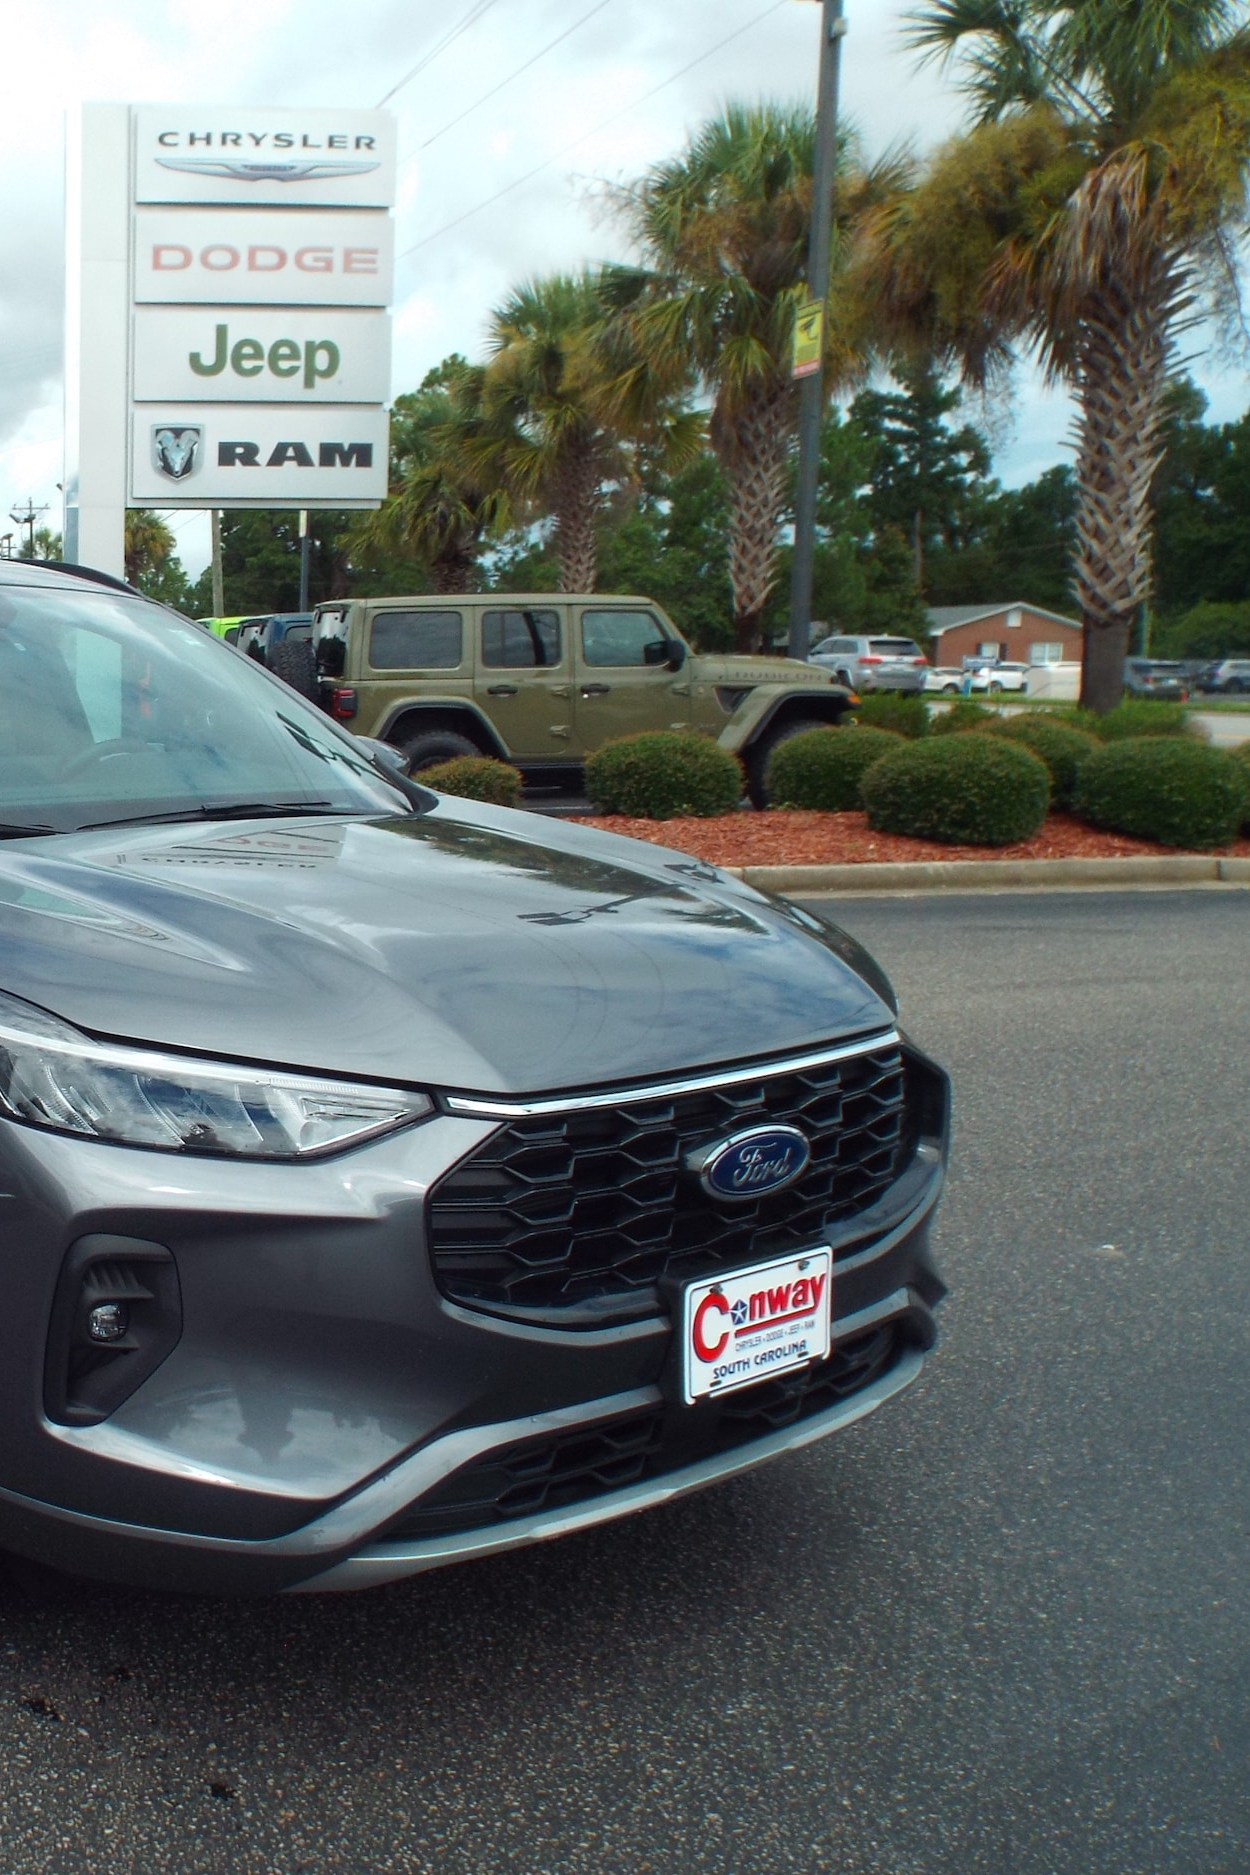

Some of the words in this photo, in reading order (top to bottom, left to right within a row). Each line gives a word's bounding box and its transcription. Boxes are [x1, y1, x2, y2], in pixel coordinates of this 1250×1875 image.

[158, 131, 377, 151] CHRYSLER
[151, 243, 379, 275] DODGE
[189, 323, 340, 389] Jeep
[217, 440, 373, 468] RAM
[733, 1142, 792, 1187] Ford
[713, 1357, 750, 1379] SOUTH
[753, 1339, 807, 1366] CAROLINA
